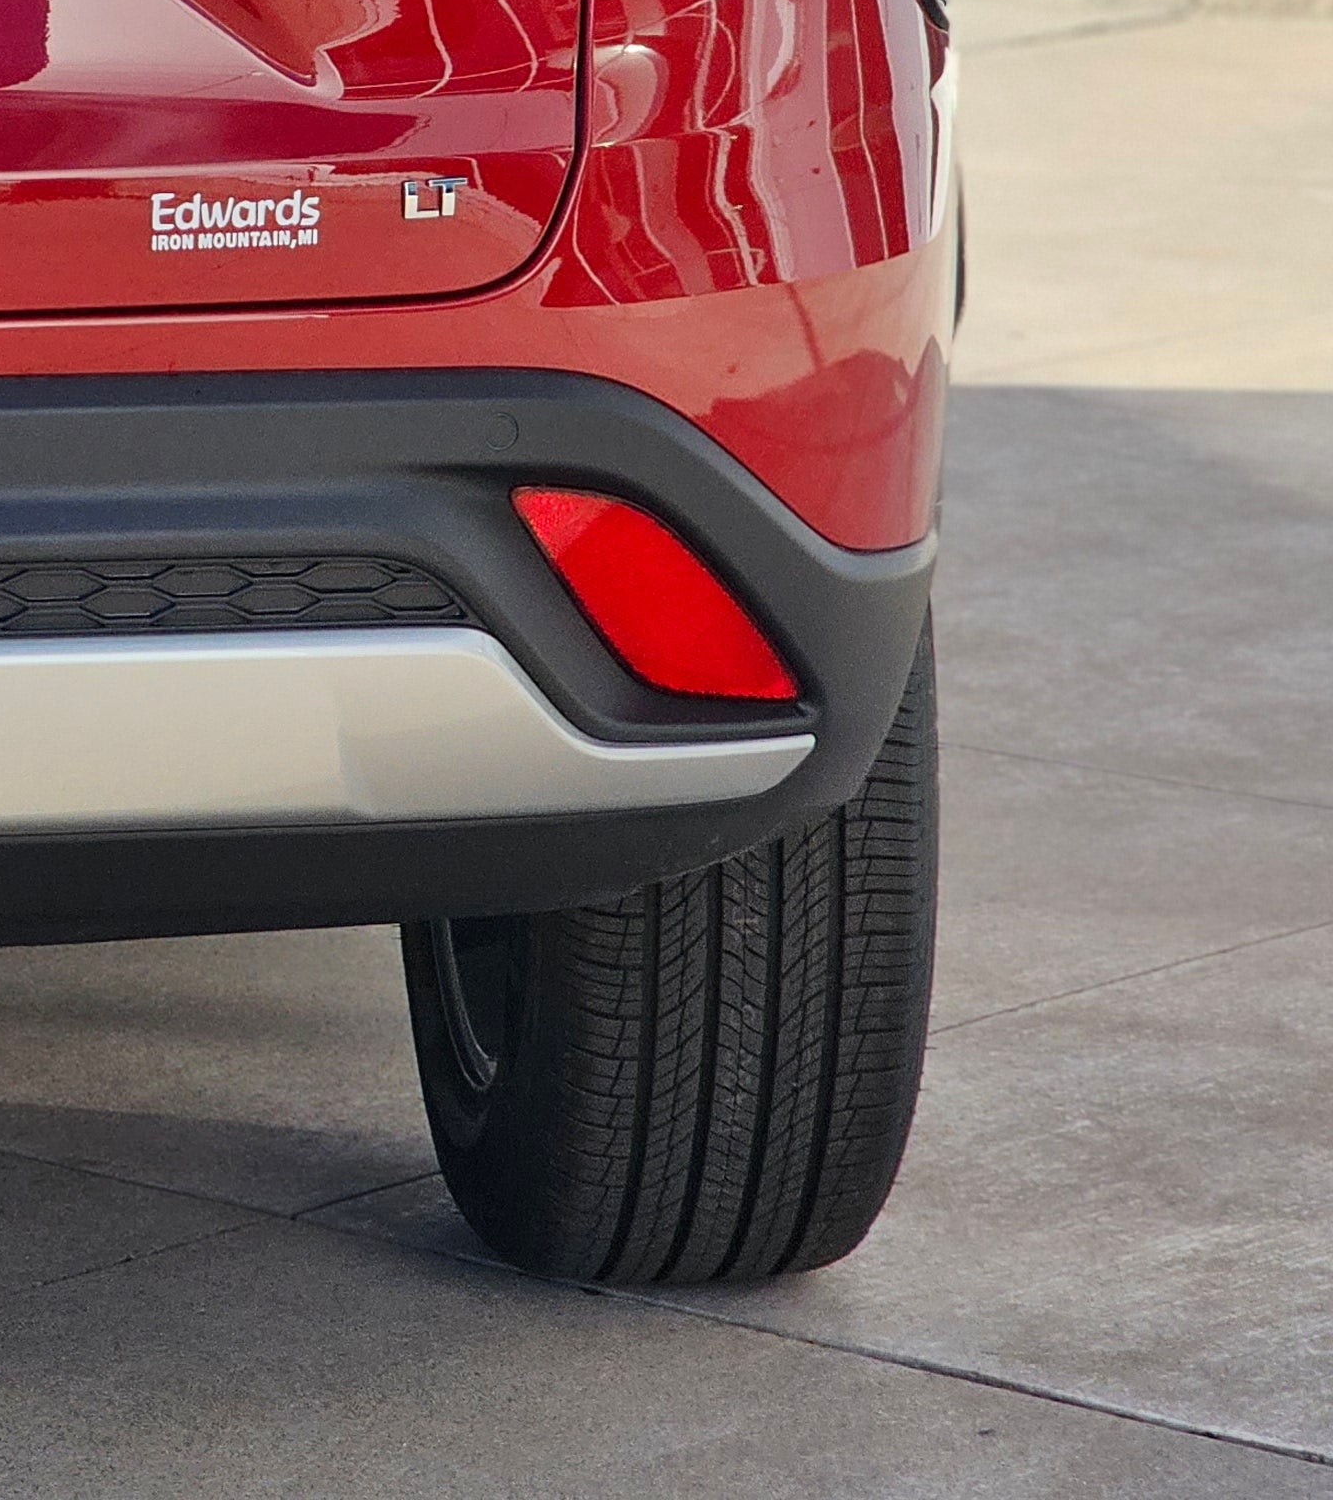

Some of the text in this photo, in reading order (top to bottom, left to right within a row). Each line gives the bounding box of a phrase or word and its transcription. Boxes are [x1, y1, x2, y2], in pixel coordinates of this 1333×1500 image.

[151, 190, 320, 231] Edwards
[402, 177, 468, 219] LT
[151, 233, 194, 251] IRON
